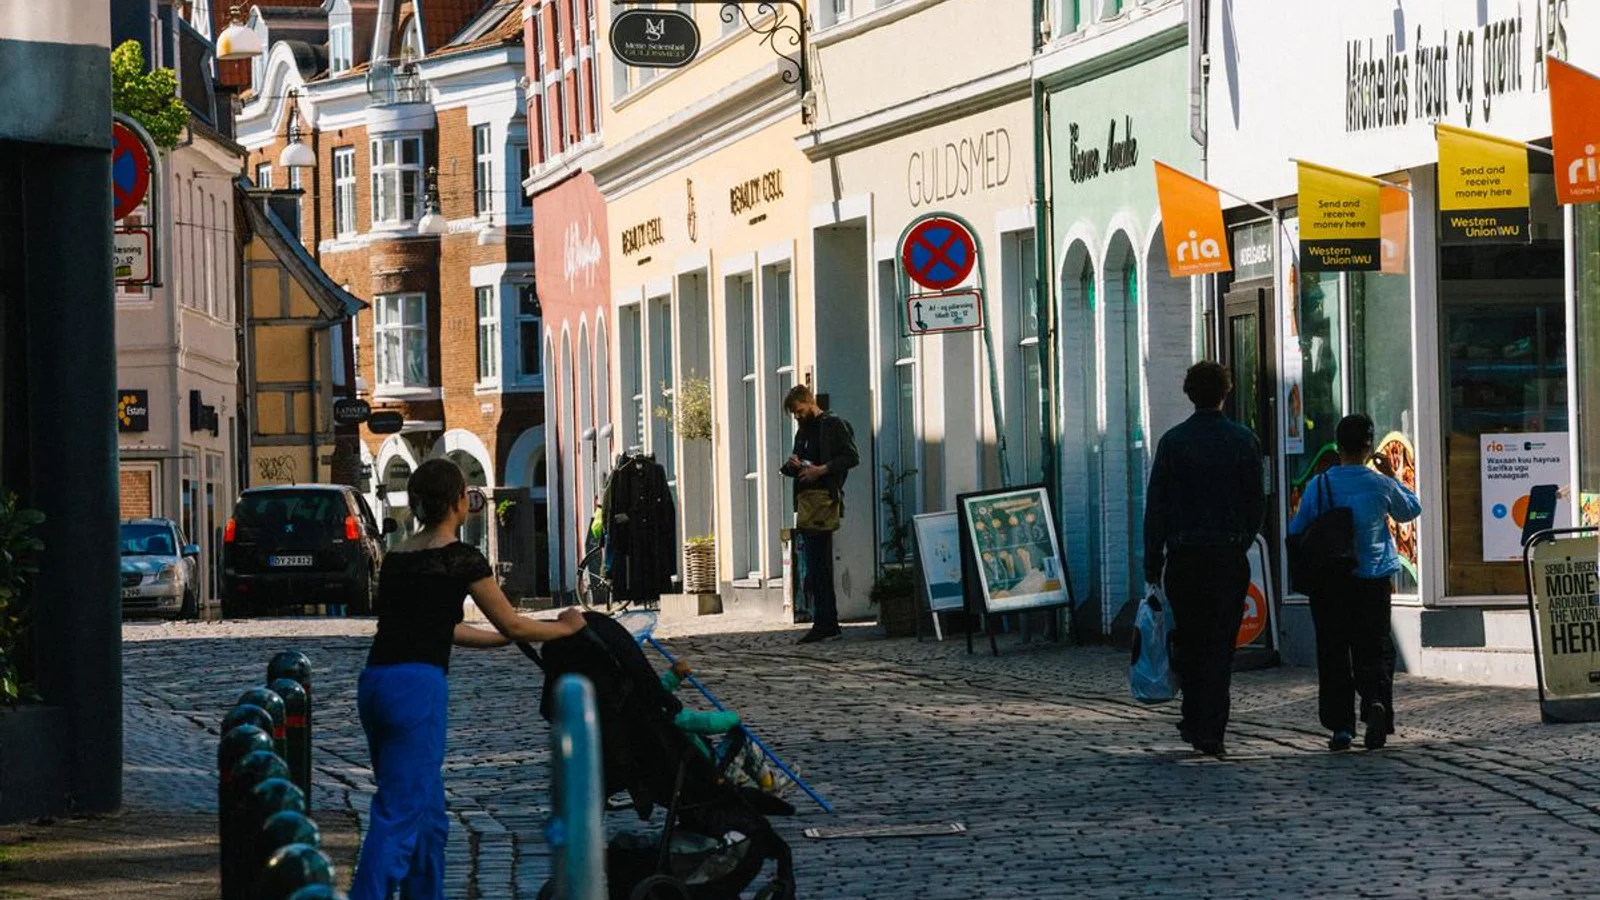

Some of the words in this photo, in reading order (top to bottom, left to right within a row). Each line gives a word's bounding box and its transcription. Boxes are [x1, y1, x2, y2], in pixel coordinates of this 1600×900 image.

[1346, 34, 1408, 132] Michellas
[1415, 24, 1448, 124] frugt
[1456, 30, 1474, 127] og
[908, 128, 1011, 207] GULDSMED
[1568, 144, 1600, 184] ri
[1460, 166, 1484, 175] Send
[1486, 165, 1505, 174] and
[763, 168, 784, 203] CELL
[1466, 178, 1500, 186] receive
[1455, 190, 1488, 198] money
[1490, 188, 1512, 196] here
[1318, 200, 1341, 208] Send
[1343, 200, 1360, 208] and
[1313, 221, 1343, 229] money
[1345, 219, 1366, 228] here
[1451, 217, 1496, 227] Western
[647, 216, 665, 246] CELL
[1466, 226, 1497, 237] Union
[1177, 230, 1220, 262] ria
[1309, 246, 1351, 256] Western
[1322, 255, 1350, 265] Union
[127, 406, 146, 416] Estate
[1486, 441, 1503, 452] ria
[1545, 564, 1565, 575] SEND
[1567, 563, 1573, 573] &
[1549, 596, 1587, 610] AROUND
[1550, 609, 1570, 622] THE
[1551, 621, 1600, 655] HER
